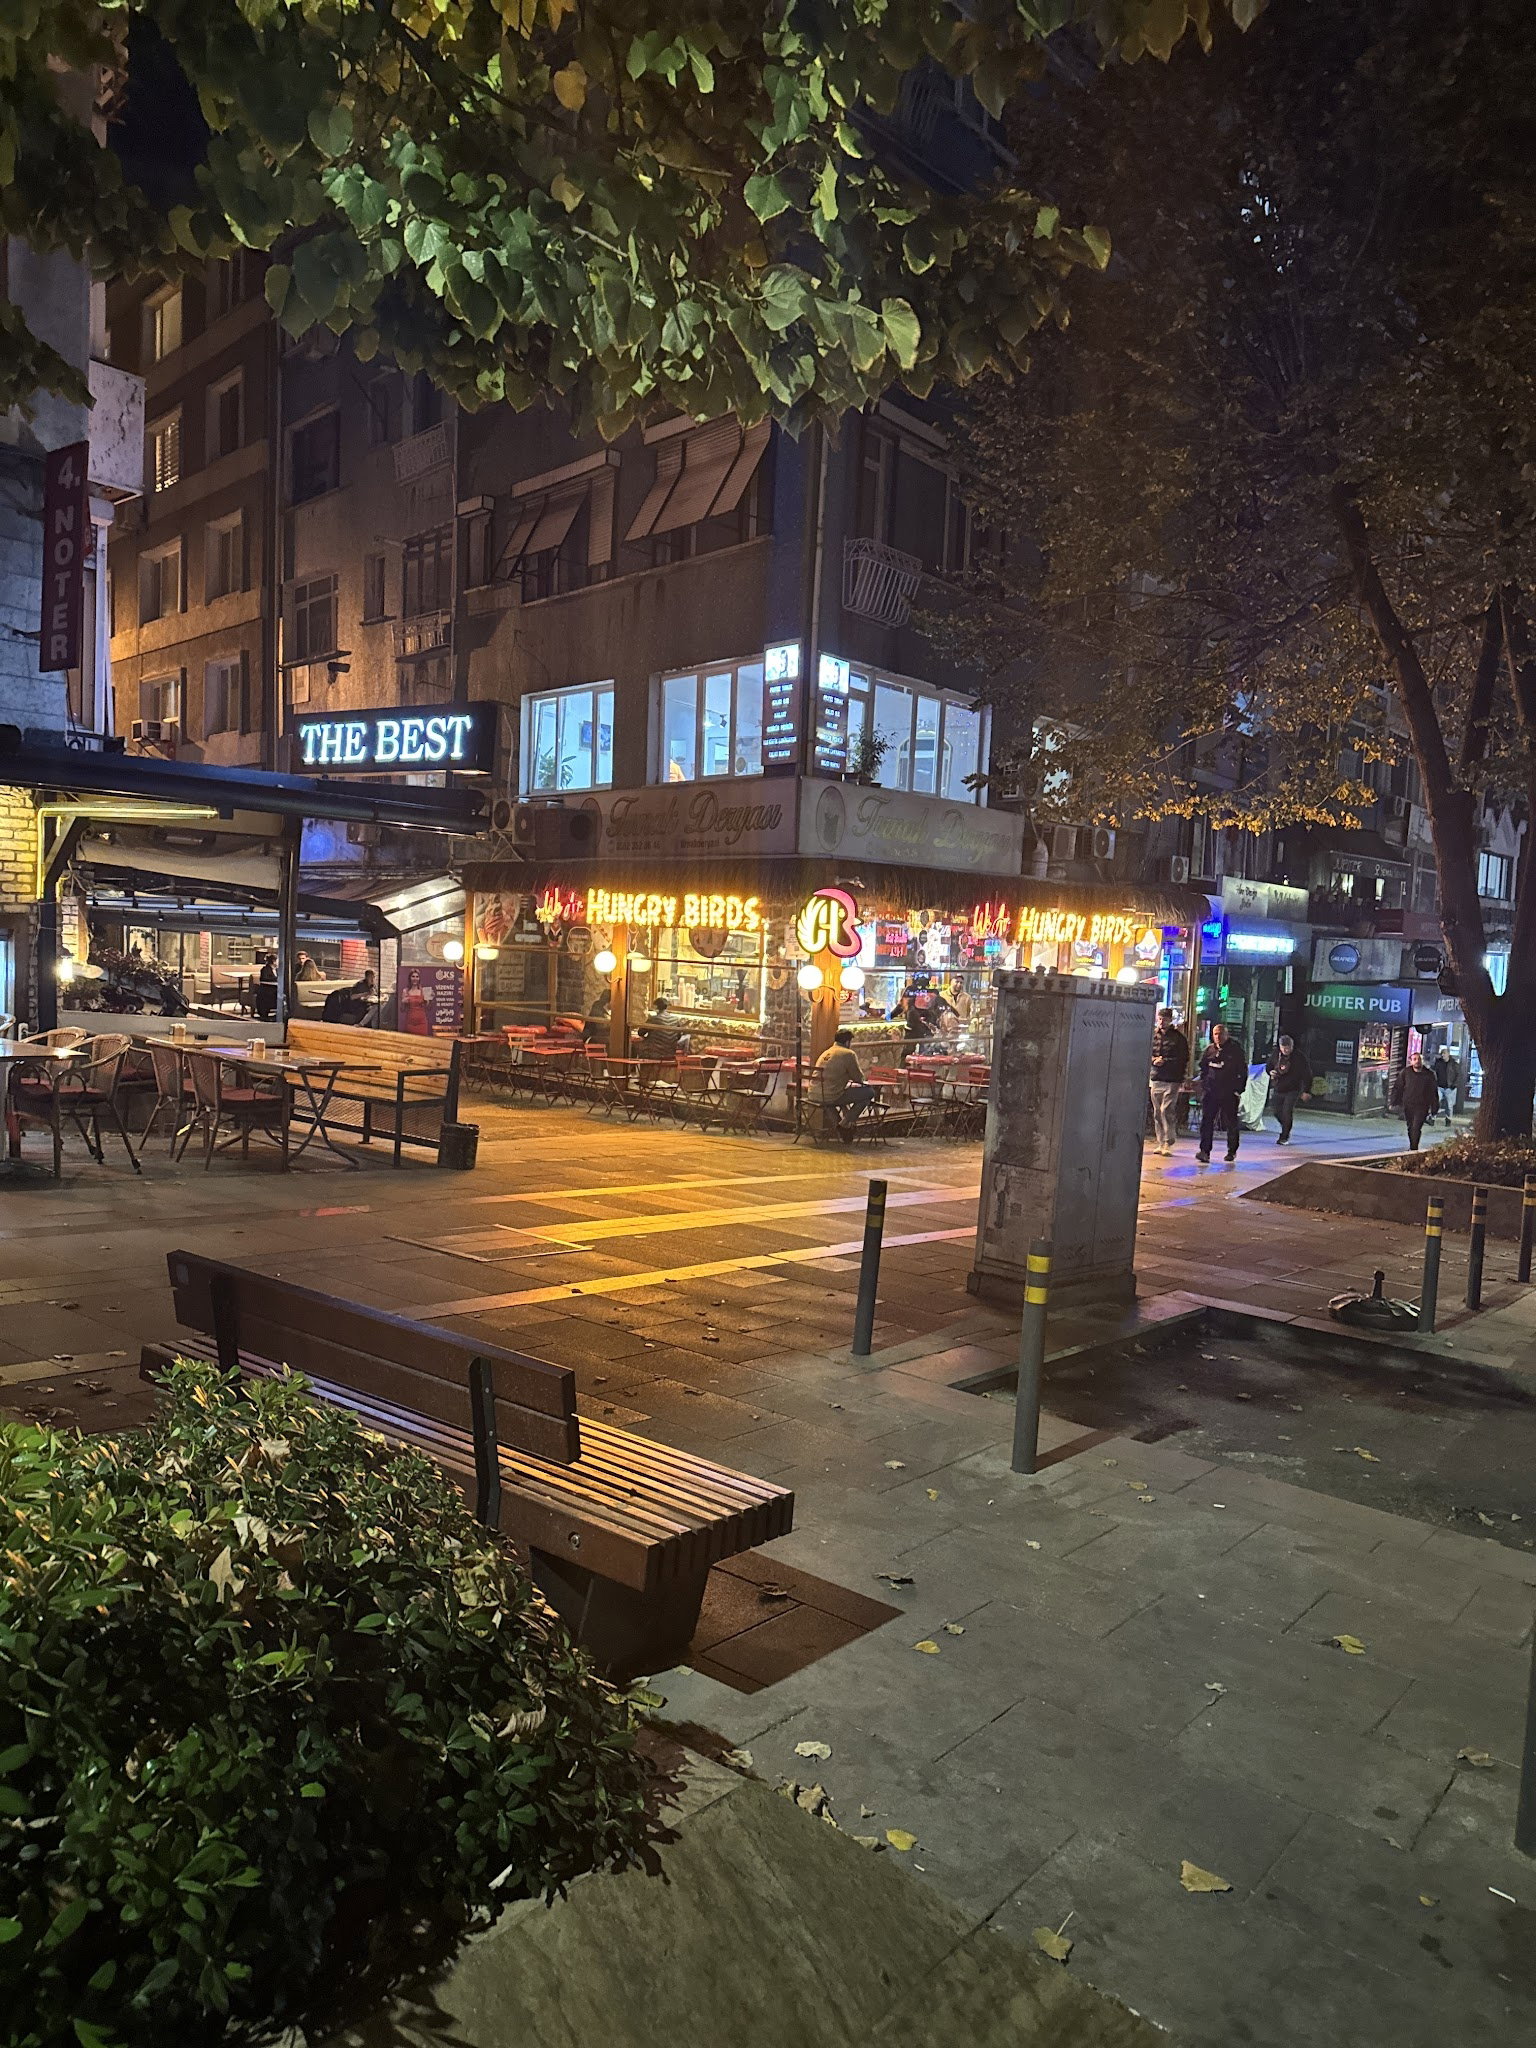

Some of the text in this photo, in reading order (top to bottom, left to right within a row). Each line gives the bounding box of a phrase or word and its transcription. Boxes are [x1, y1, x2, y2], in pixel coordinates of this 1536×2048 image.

[50, 455, 81, 661] 4. NOTER
[300, 714, 472, 765] THE BEST
[586, 887, 677, 928] HUNGRY
[684, 894, 762, 931] BIRDS
[1018, 906, 1087, 943] HUNGRY
[1090, 913, 1134, 944] BIRDS
[1303, 993, 1402, 1013] JUPITER PUB
